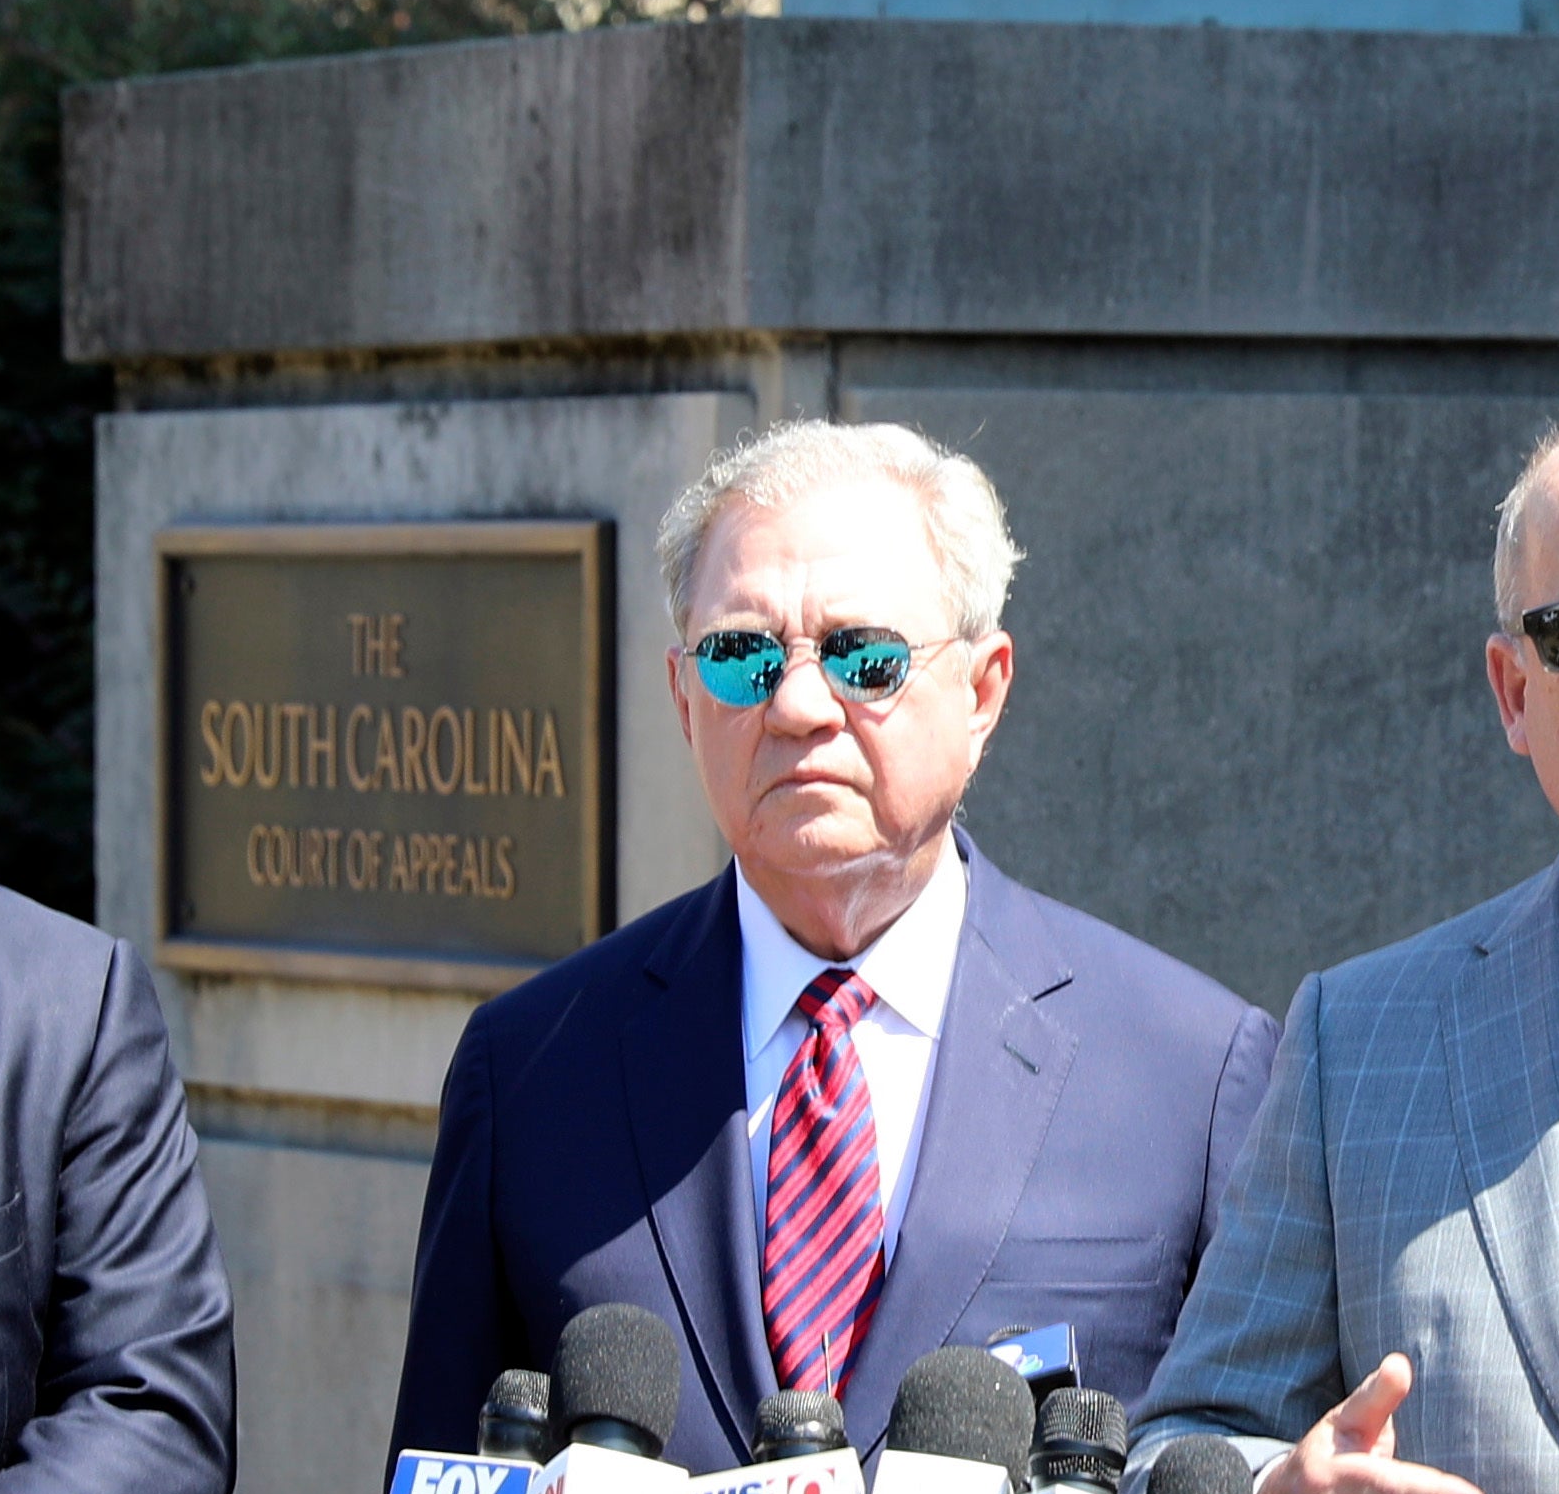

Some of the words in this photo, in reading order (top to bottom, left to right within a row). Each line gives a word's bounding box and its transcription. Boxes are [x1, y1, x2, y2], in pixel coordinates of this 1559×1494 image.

[348, 614, 406, 678] THE
[200, 700, 338, 790] SOUTH
[345, 706, 566, 798] CAROLINA
[247, 824, 340, 888] COURT
[345, 828, 380, 891] OF
[390, 833, 515, 899] APPEALS
